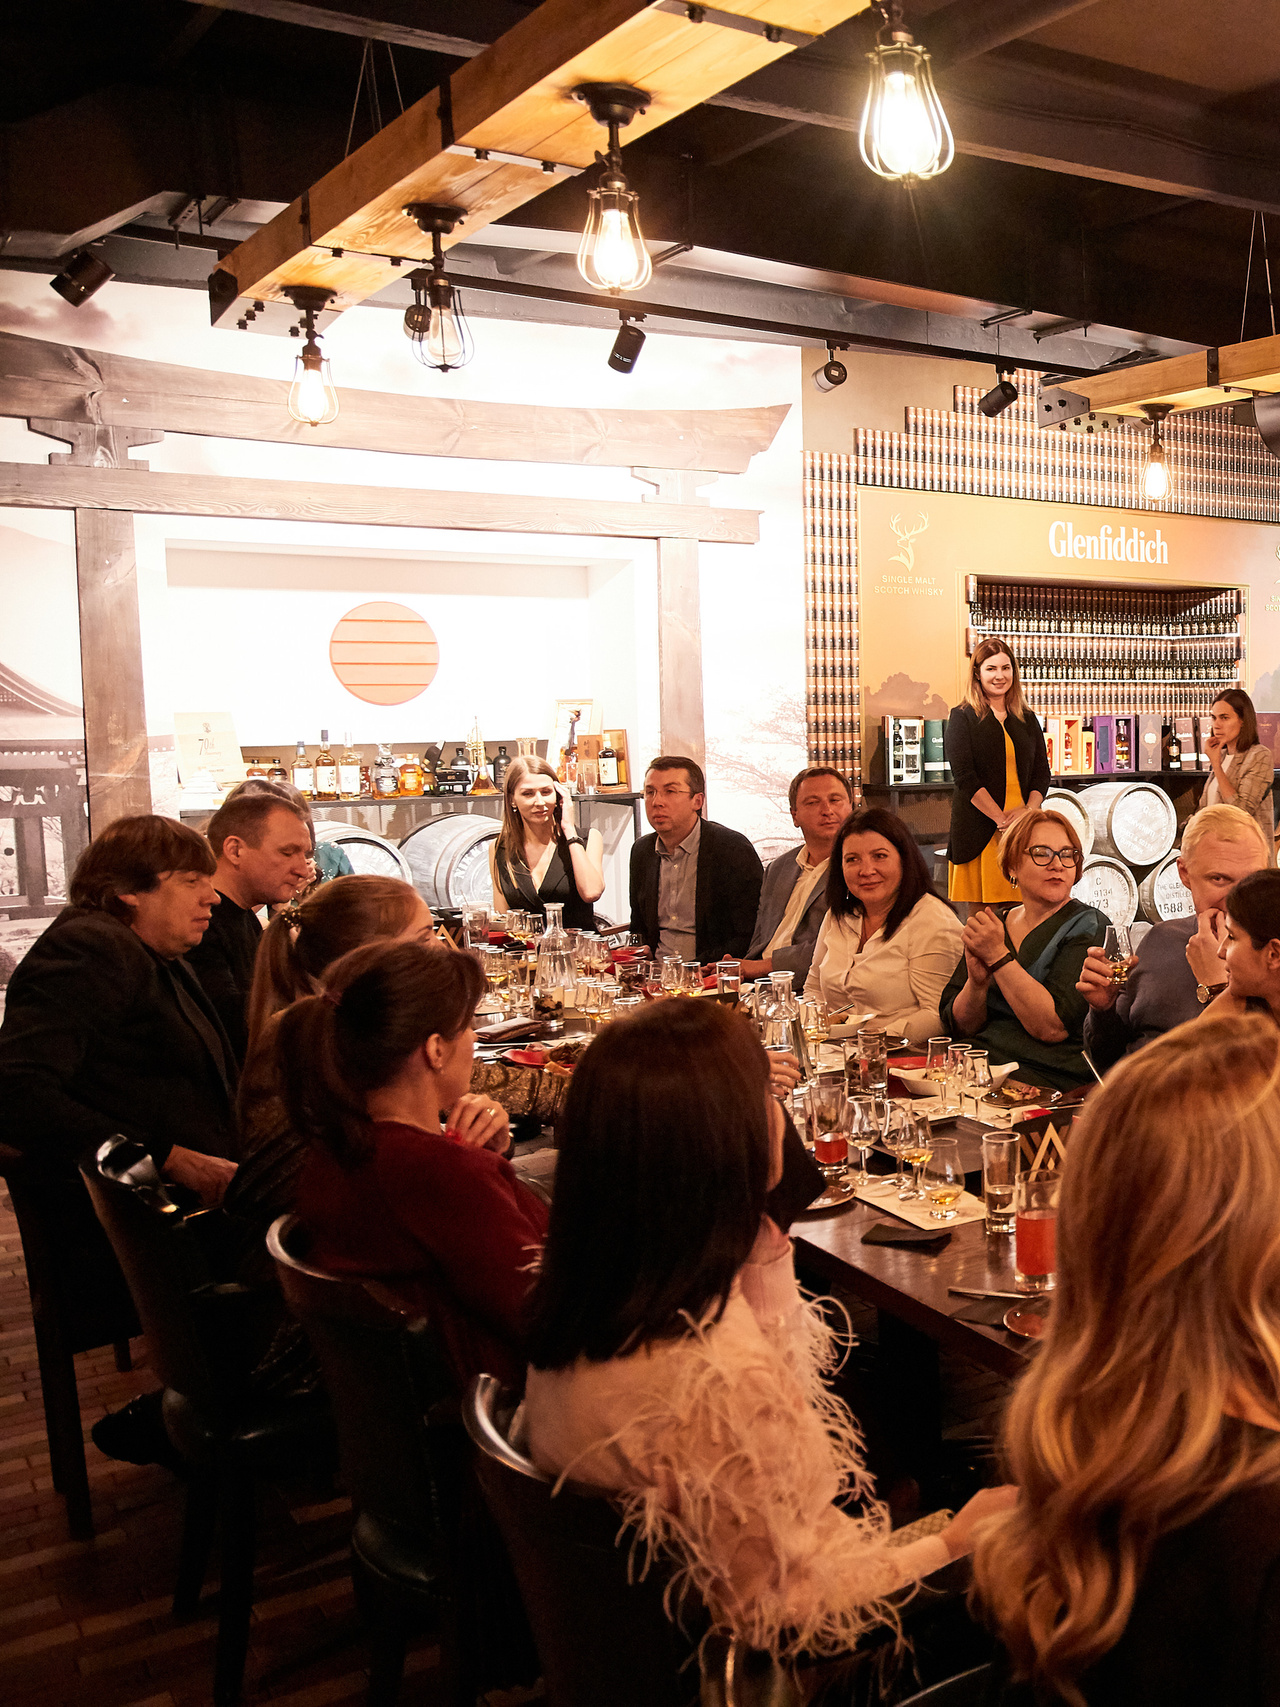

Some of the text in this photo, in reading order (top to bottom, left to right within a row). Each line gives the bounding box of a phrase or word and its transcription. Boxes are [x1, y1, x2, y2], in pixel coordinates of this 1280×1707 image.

[1048, 520, 1169, 565] Glenfiddich
[882, 575, 936, 586] SINGLE MALT
[874, 585, 944, 597] SCOTCH WHISKY
[1094, 888, 1113, 898] 9134
[1158, 901, 1183, 915] 1588
